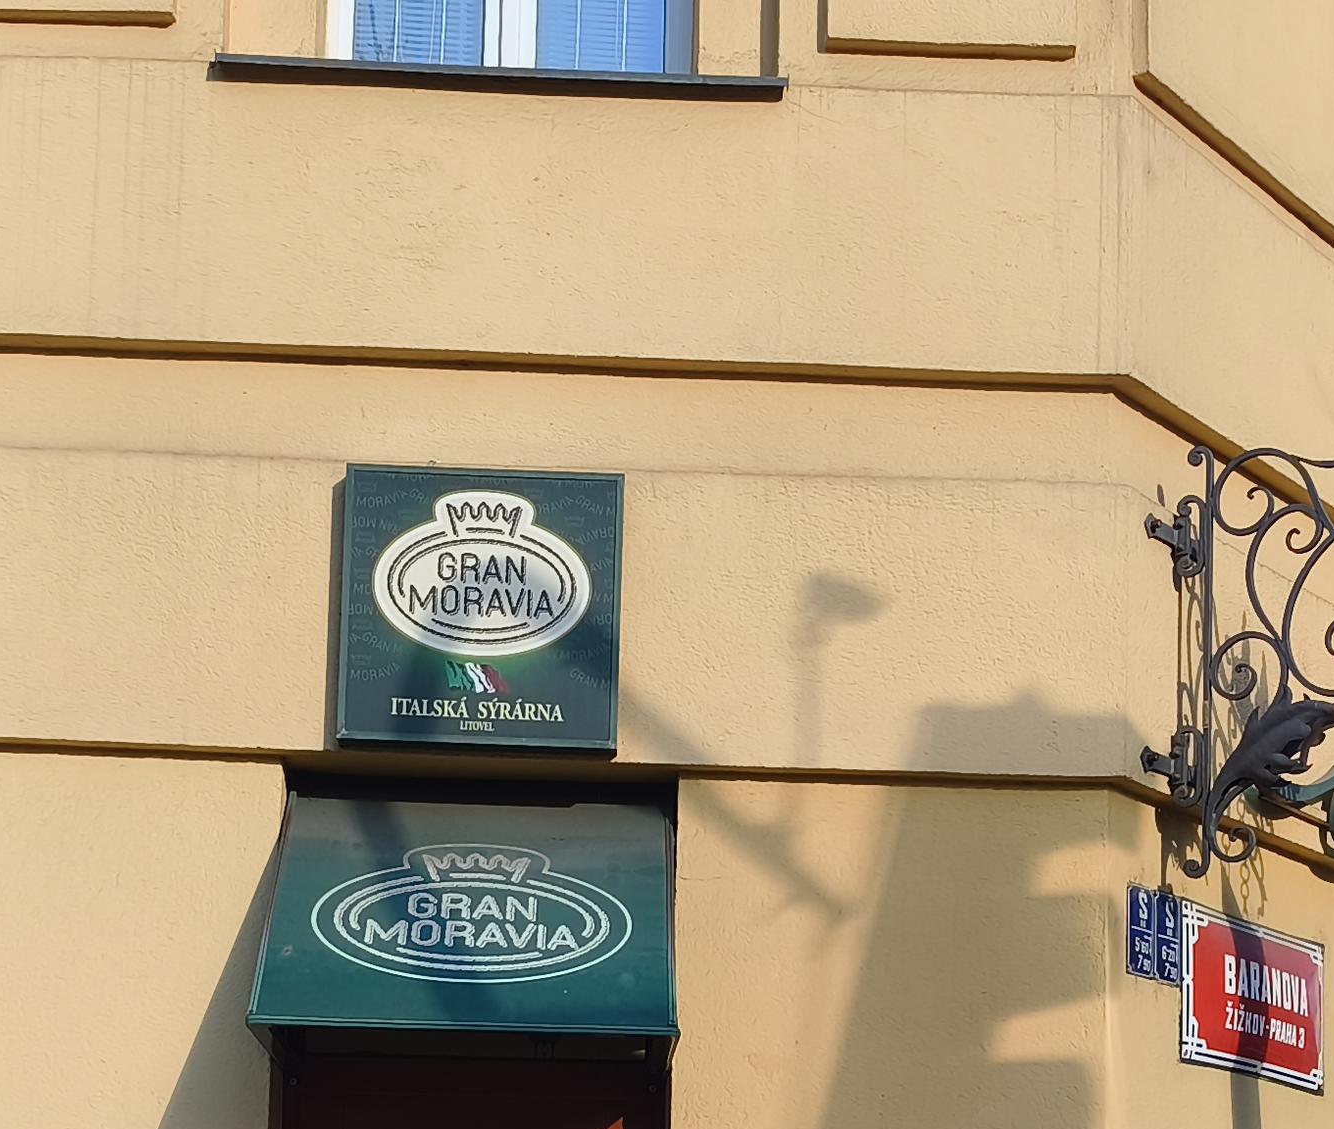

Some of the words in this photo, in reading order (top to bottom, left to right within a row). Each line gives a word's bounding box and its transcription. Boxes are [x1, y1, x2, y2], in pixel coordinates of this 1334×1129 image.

[437, 552, 528, 584] GRAN
[409, 583, 555, 618] MORAVIA
[390, 696, 470, 719] ITALSKÁ
[477, 699, 564, 723] SÝRÁRNA
[460, 720, 495, 732] LITOVEL
[407, 891, 538, 923] GRAN
[363, 918, 579, 953] MORAVIA
[1223, 953, 1309, 1017] BARANOVA
[1298, 1027, 1306, 1049] 3
